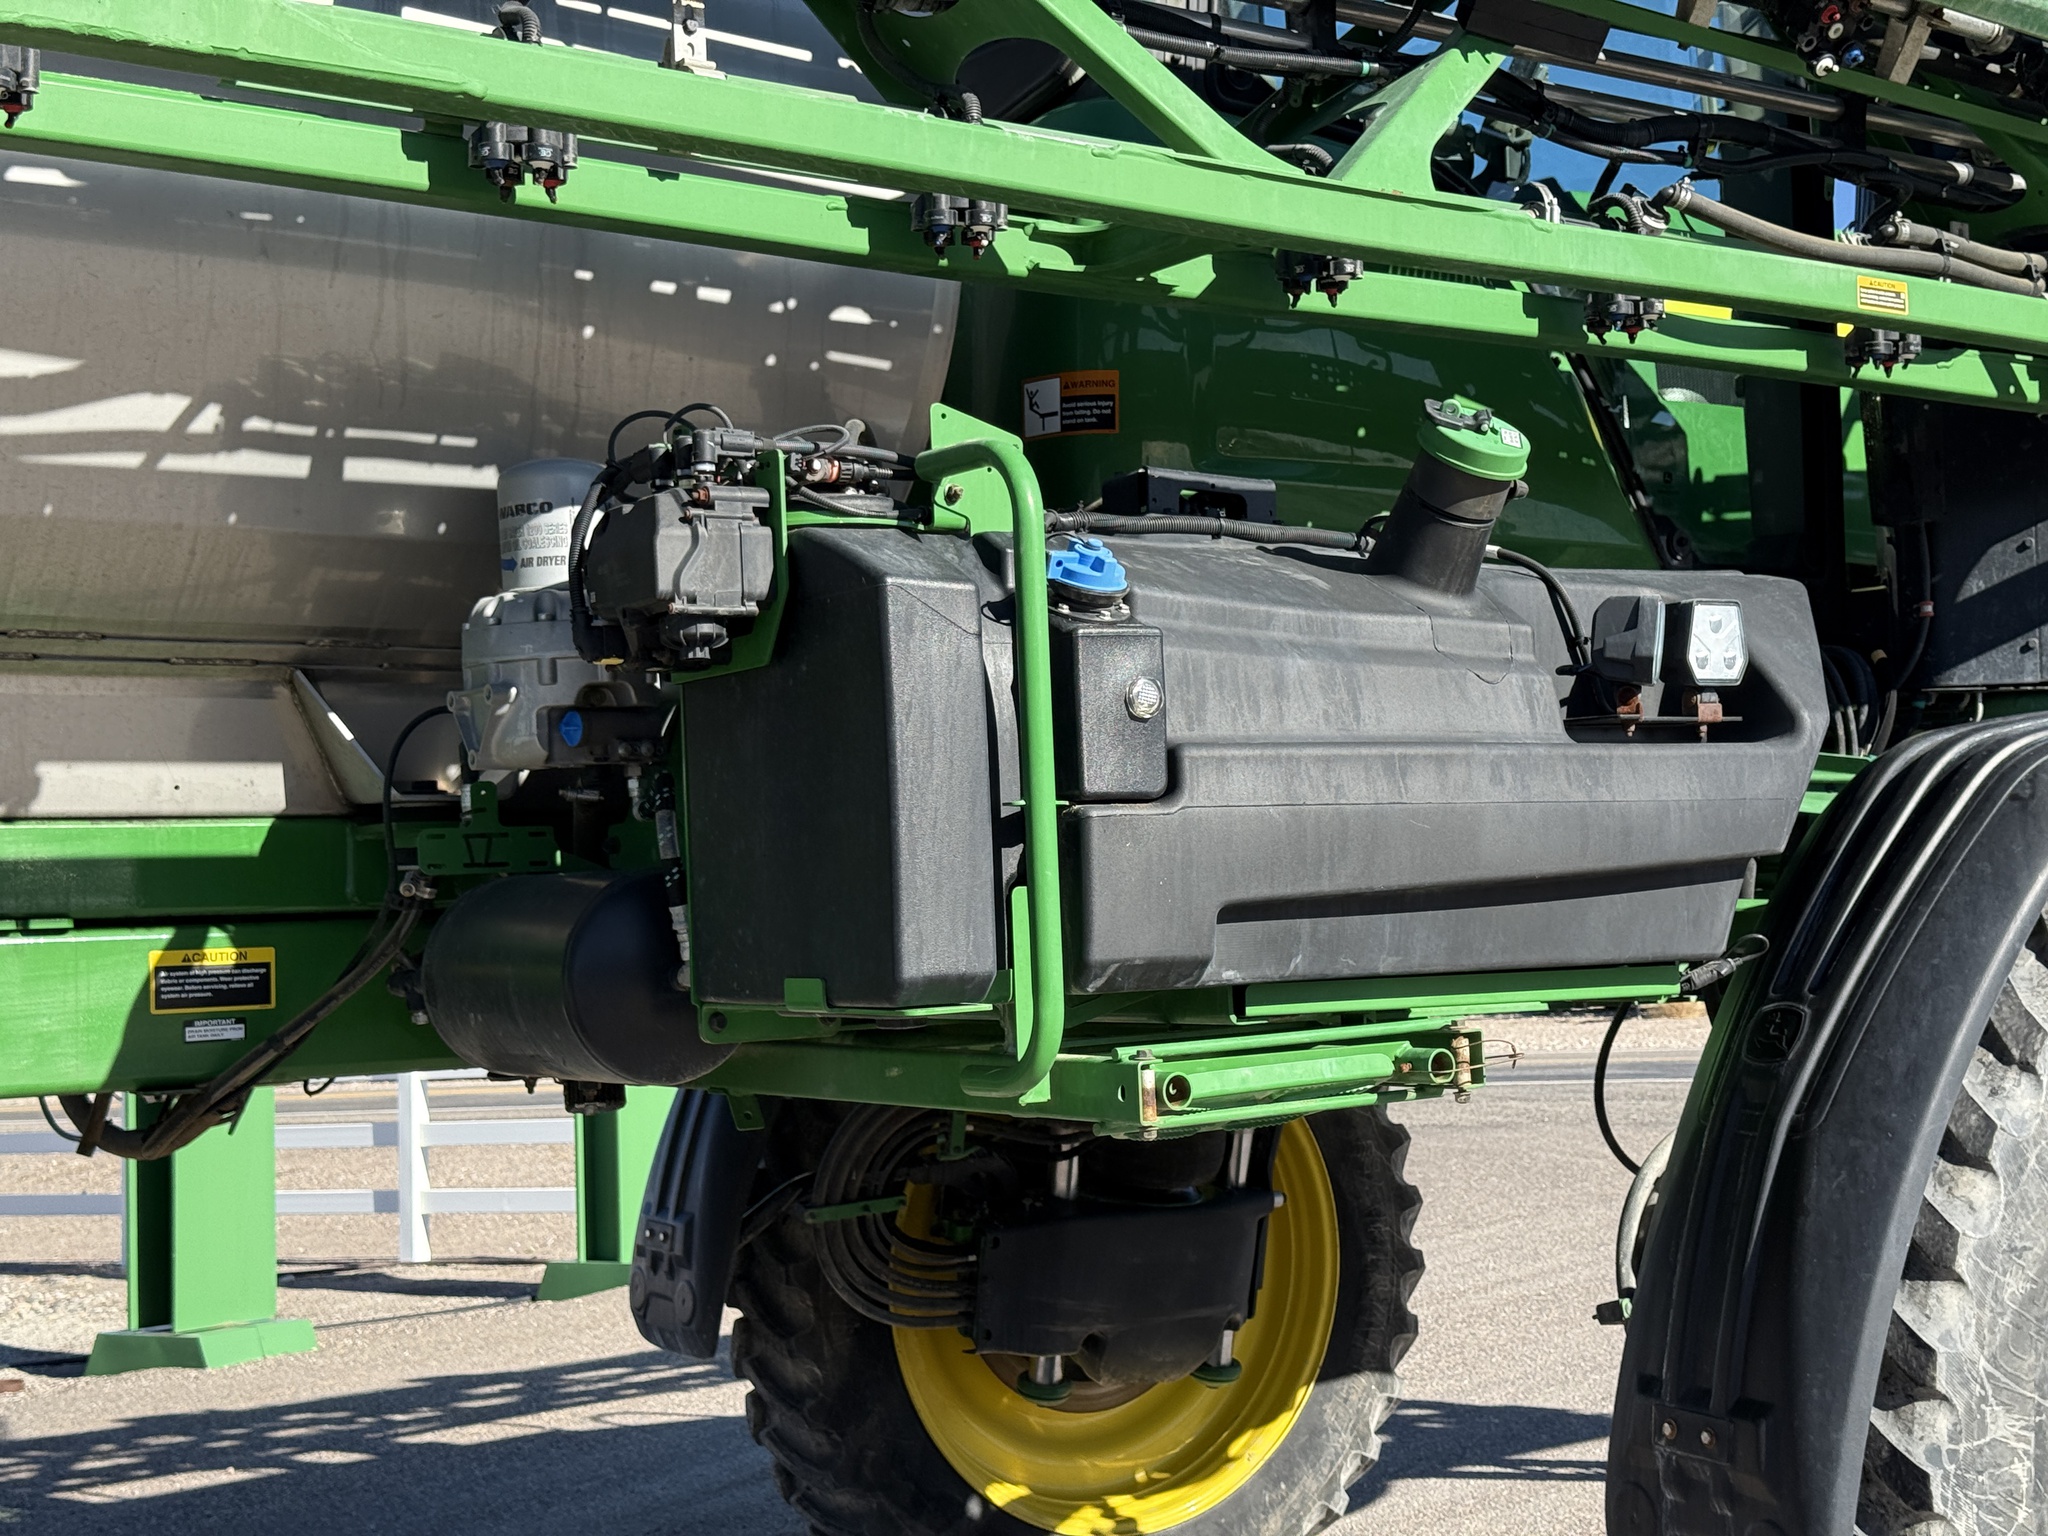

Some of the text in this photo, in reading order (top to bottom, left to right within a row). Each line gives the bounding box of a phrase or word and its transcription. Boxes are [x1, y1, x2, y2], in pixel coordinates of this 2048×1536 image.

[1873, 280, 1896, 289] CAUTION
[1070, 380, 1115, 389] WARNING
[1097, 400, 1114, 408] injury
[544, 522, 568, 535] SERIES
[520, 555, 566, 568] AIR DRYER
[192, 951, 248, 963] CAUTION
[242, 967, 267, 975] discharge
[185, 977, 218, 985] components.
[194, 1018, 236, 1027] IMPORTANT
